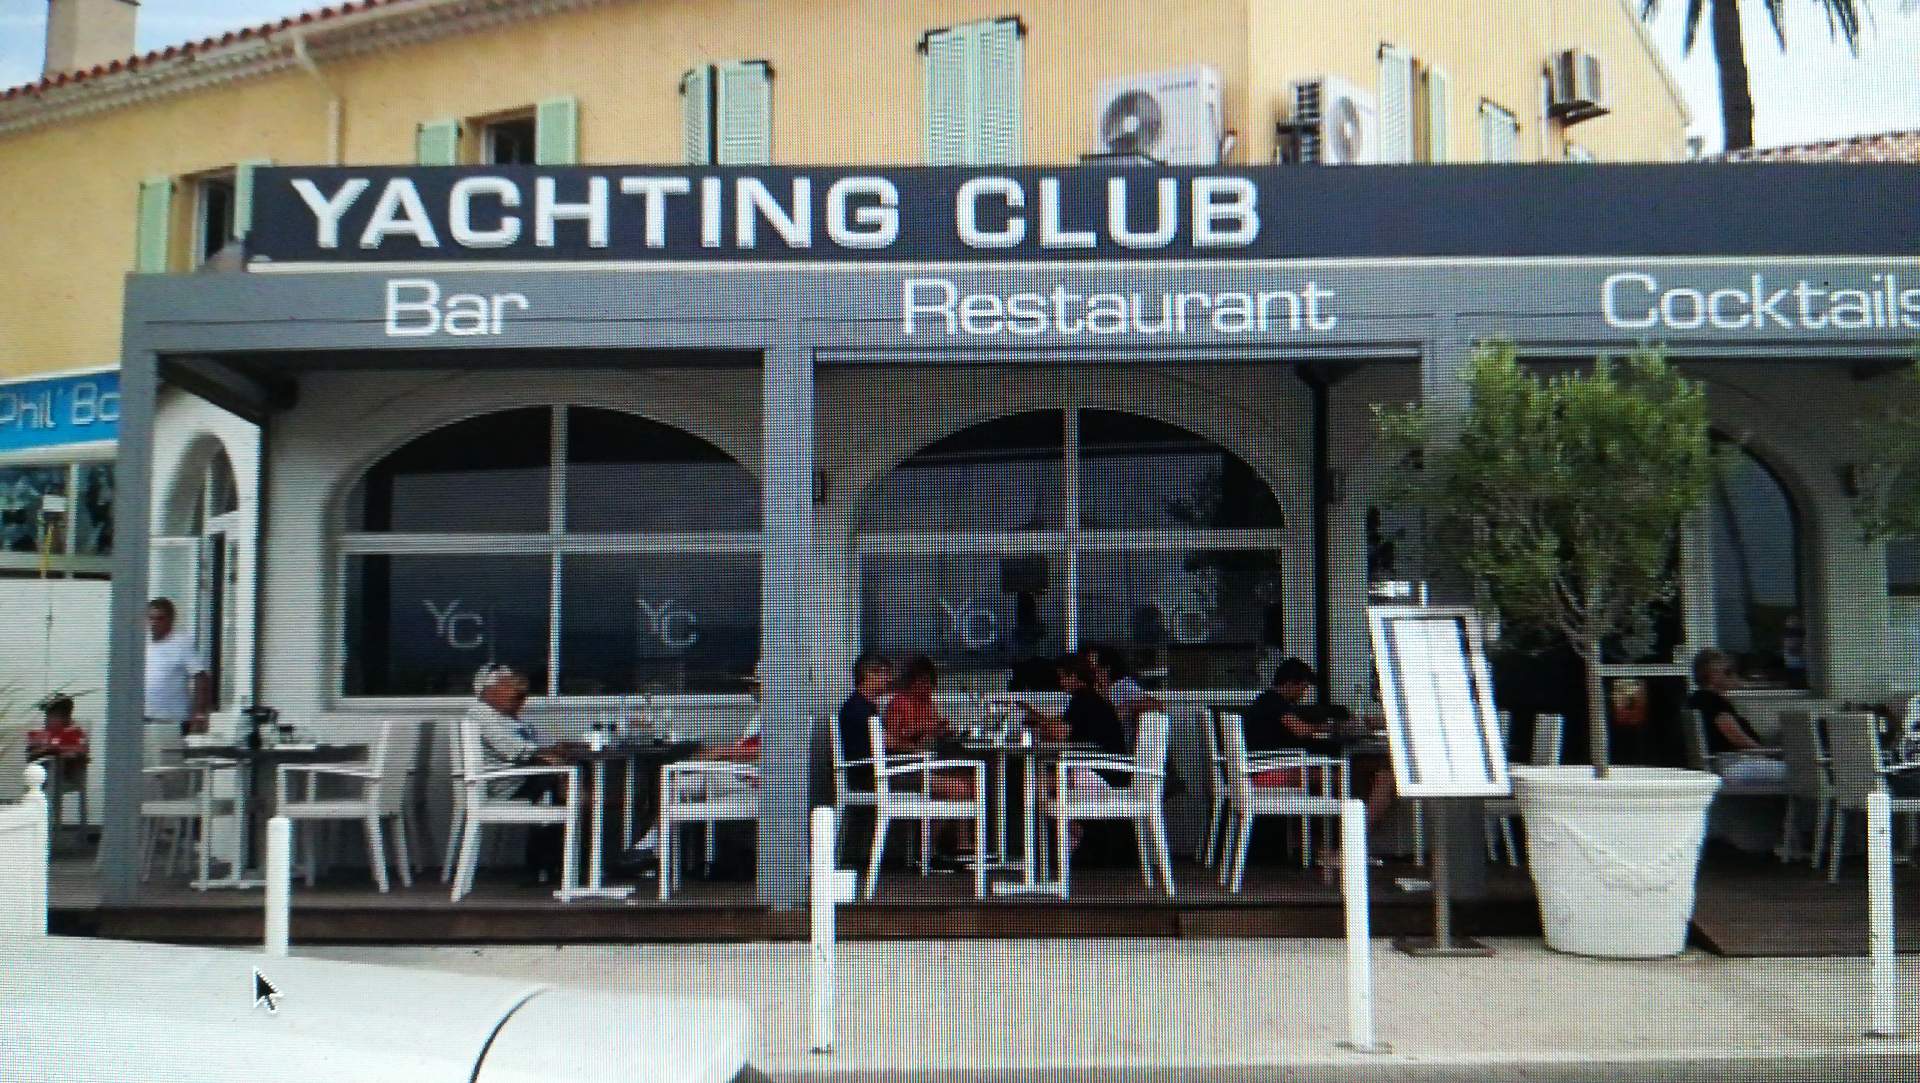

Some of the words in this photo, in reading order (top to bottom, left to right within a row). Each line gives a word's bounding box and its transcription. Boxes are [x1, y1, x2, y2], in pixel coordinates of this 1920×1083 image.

[291, 176, 900, 249] YACHTING
[956, 176, 1262, 248] CLUB
[383, 278, 529, 338] Bar
[902, 277, 1338, 335] Restaurant
[1602, 272, 1920, 329] Cocktails
[422, 599, 484, 648] YC
[636, 599, 698, 648] YC
